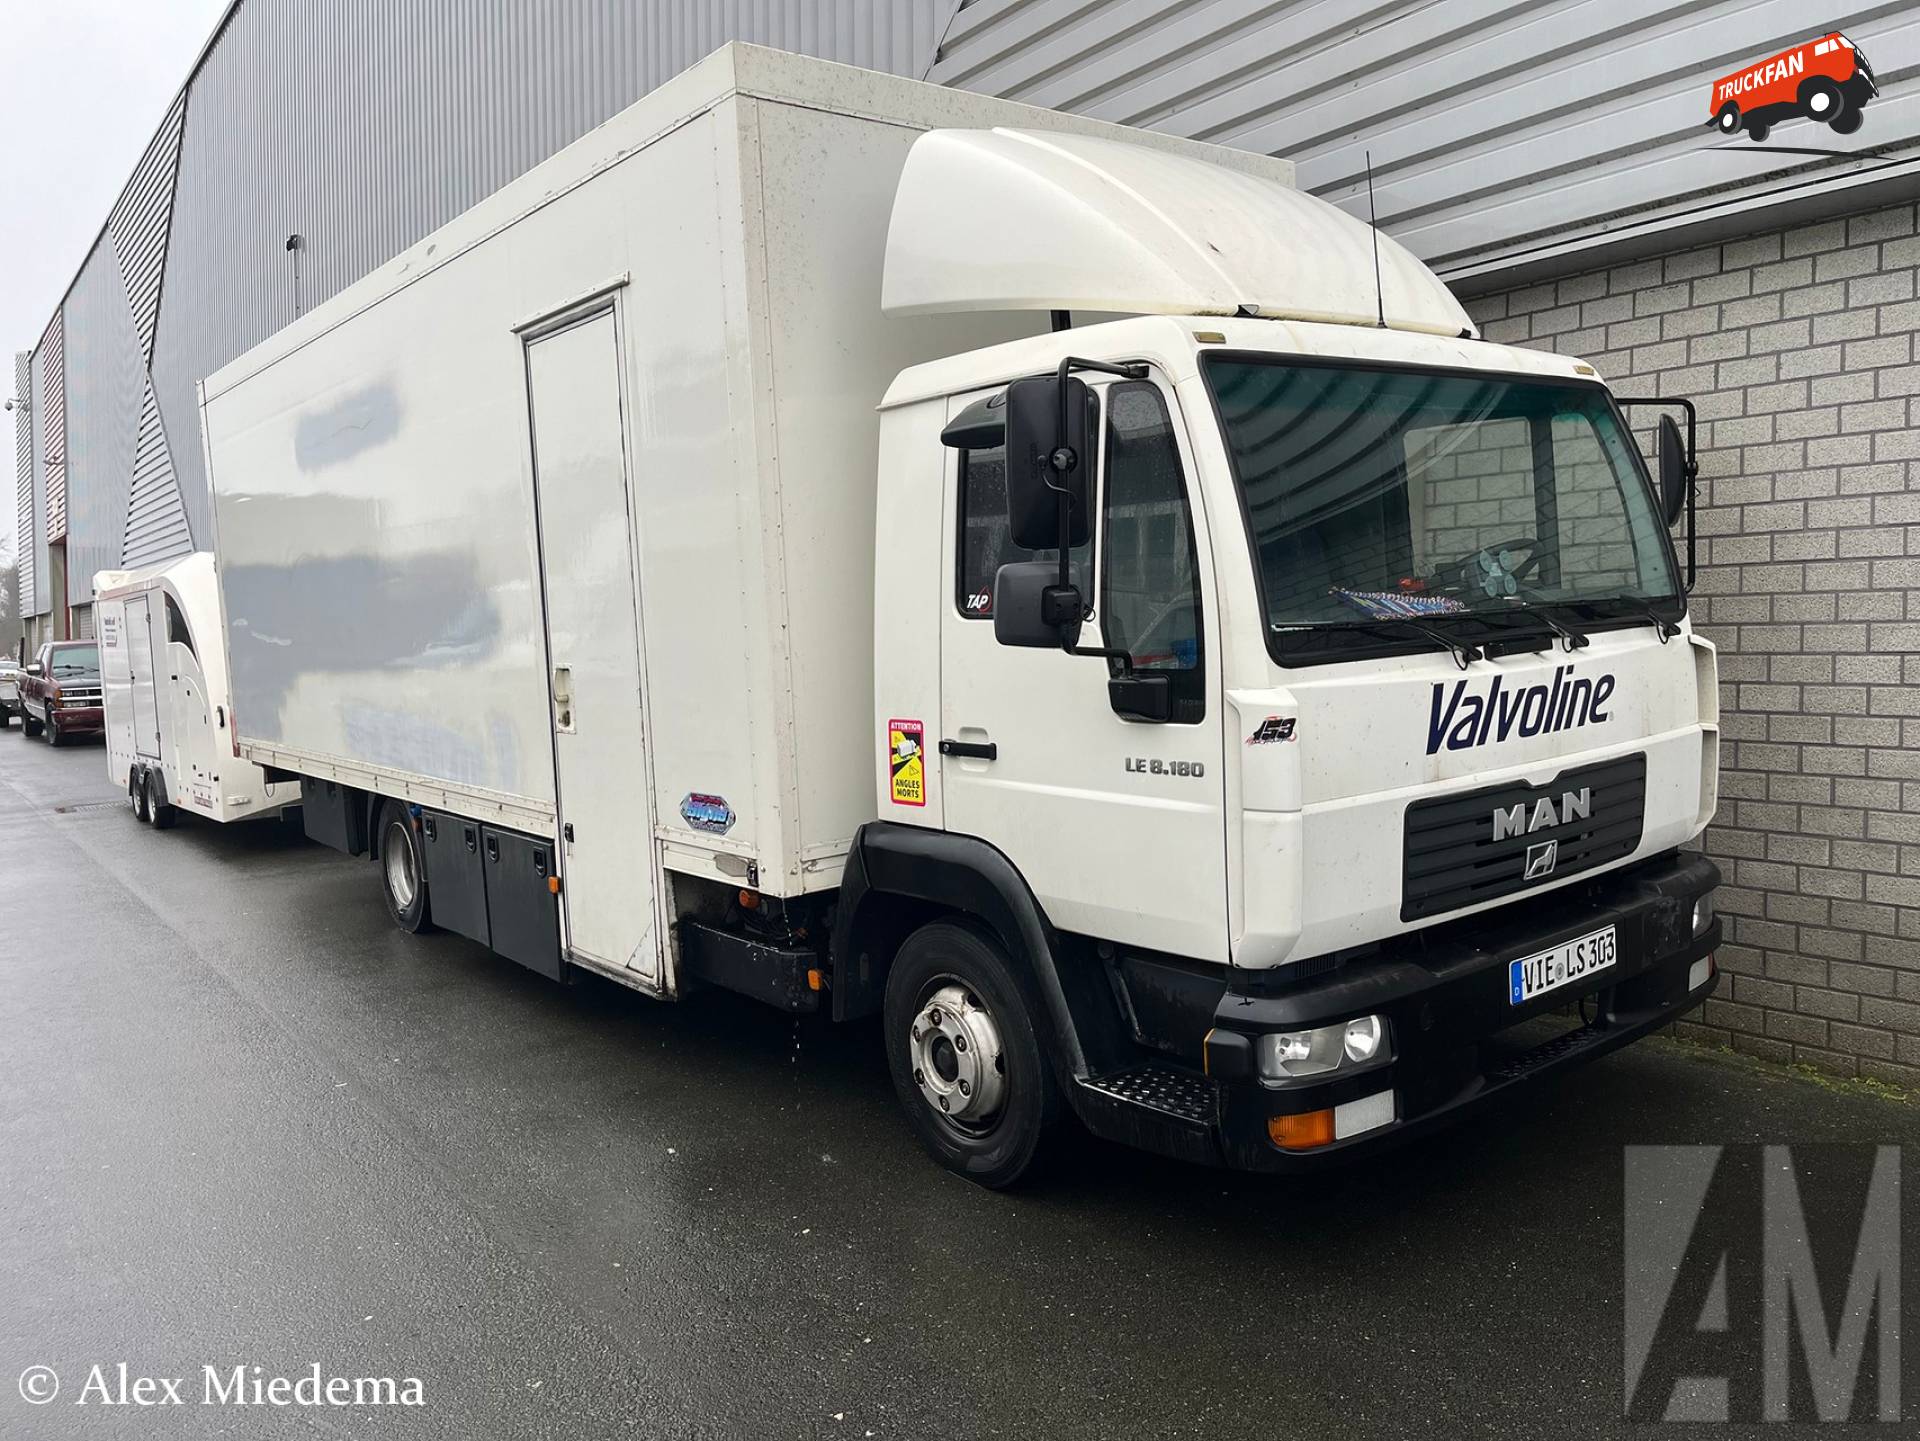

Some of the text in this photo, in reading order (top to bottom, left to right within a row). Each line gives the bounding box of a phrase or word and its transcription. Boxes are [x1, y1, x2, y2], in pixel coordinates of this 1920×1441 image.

[967, 594, 989, 608] TAP
[1426, 665, 1615, 755] Valvoline
[1125, 757, 1204, 778] LE 8.180
[896, 779, 919, 788] ANGLES
[897, 788, 919, 798] MORTS
[1493, 787, 1590, 841] MAN
[1524, 955, 1555, 993] VIE
[1567, 943, 1585, 978] LS
